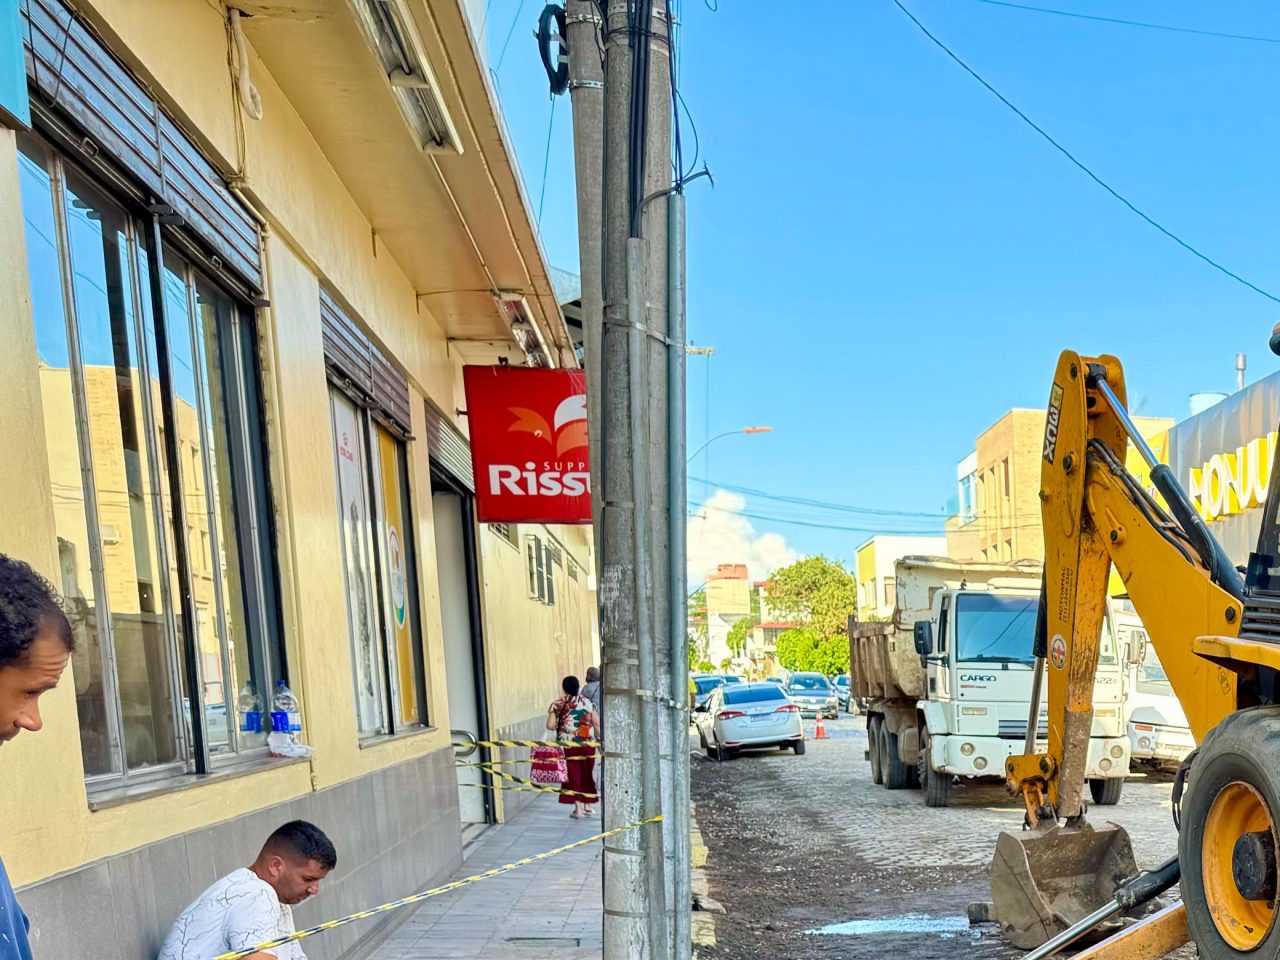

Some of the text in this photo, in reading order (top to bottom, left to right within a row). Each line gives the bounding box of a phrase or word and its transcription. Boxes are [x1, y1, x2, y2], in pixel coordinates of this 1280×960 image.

[1043, 406, 1060, 462] 3CX
[543, 461, 585, 471] SUPP
[960, 674, 997, 682] CARGO
